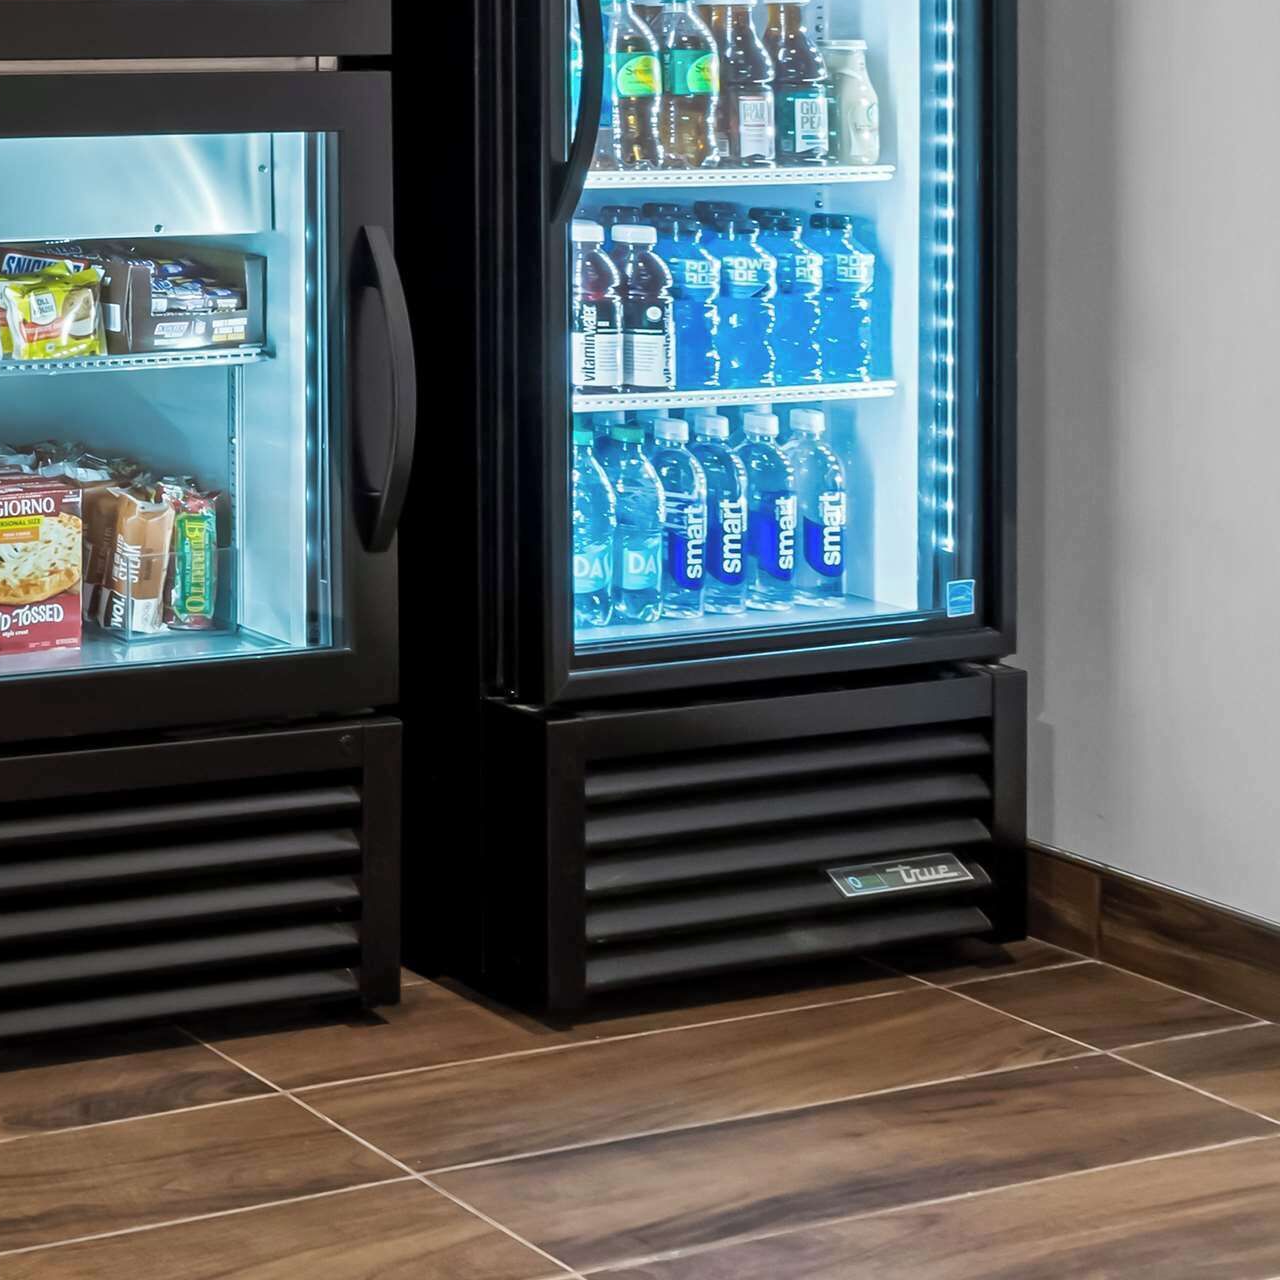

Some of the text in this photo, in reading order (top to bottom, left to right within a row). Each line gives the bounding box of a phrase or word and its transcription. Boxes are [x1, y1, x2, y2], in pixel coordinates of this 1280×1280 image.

[687, 504, 707, 580] smart
[721, 499, 743, 575] smart
[778, 494, 797, 571] smart
[819, 492, 845, 567] smart
[886, 864, 958, 883] true
